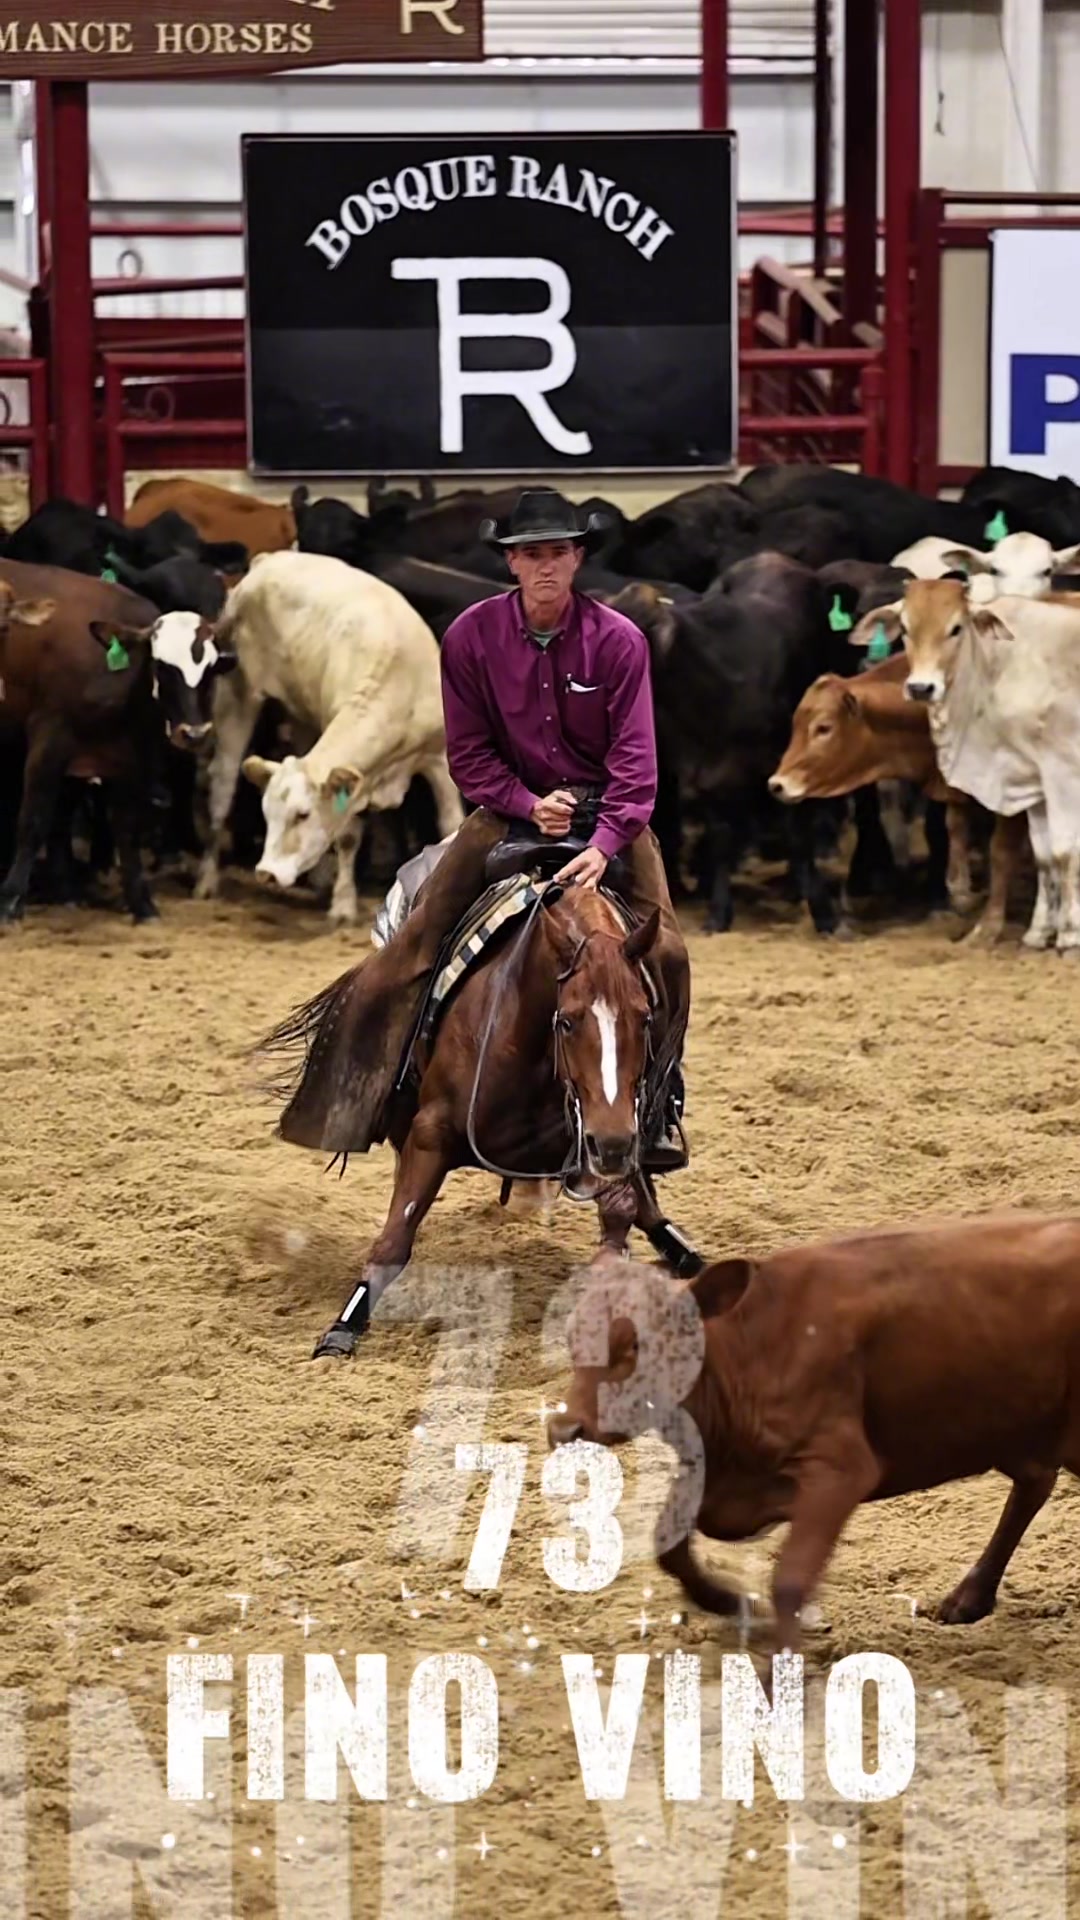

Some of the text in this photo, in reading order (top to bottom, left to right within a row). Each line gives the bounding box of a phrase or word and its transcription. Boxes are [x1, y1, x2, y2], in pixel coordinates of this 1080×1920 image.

[155, 23, 313, 53] HORSES
[305, 154, 675, 270] BOSQUE RANCH
